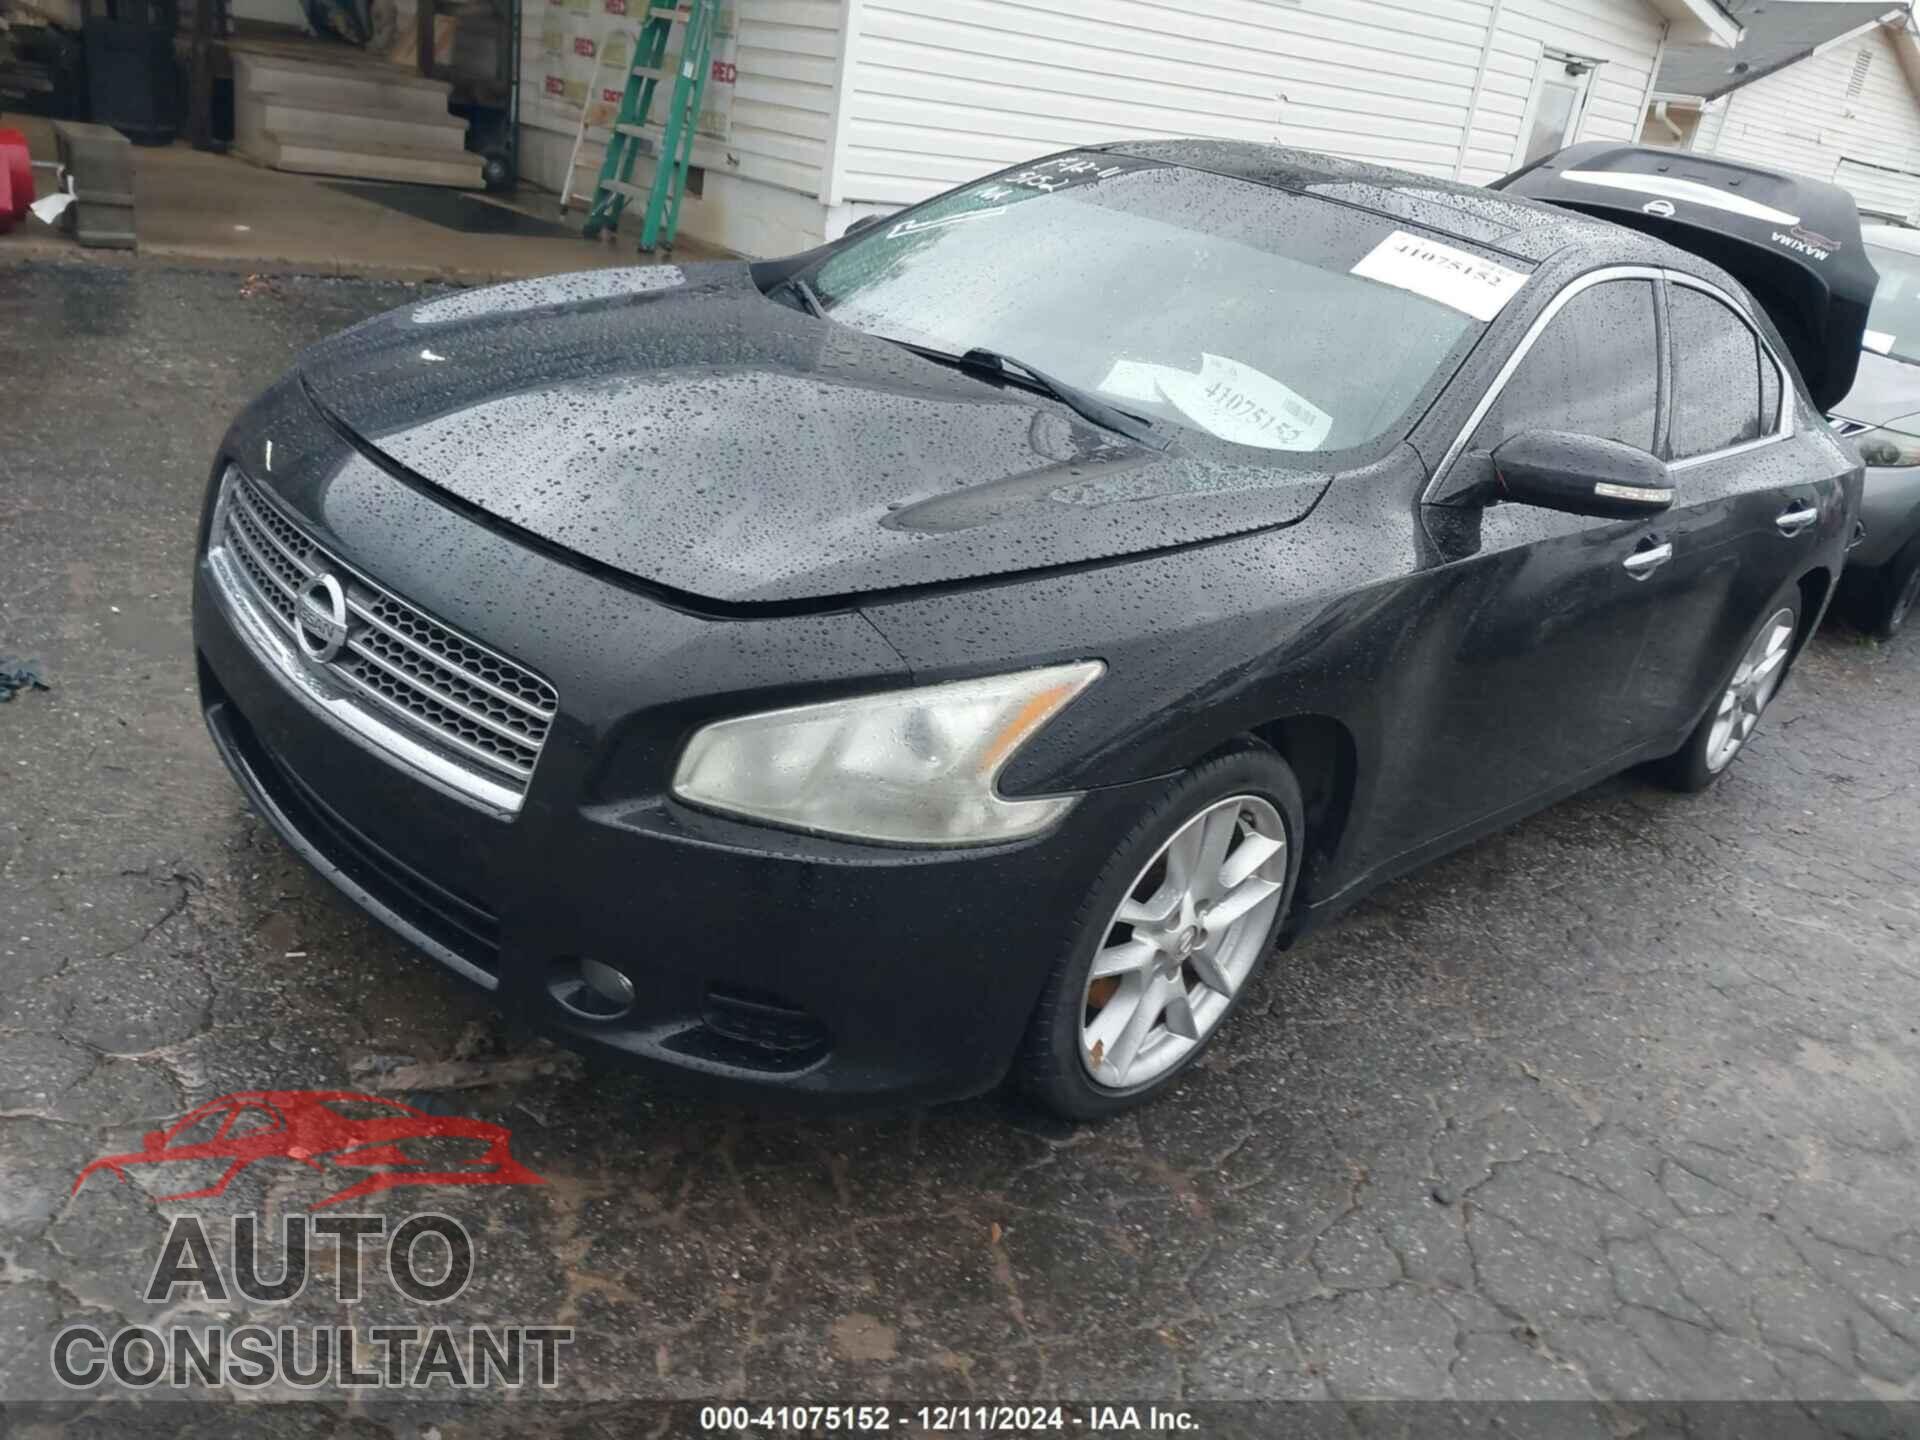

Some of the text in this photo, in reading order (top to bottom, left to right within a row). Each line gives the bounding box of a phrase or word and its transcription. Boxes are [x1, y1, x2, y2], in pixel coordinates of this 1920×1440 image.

[1395, 244, 1503, 287] 41075152
[1771, 232, 1830, 261] MAXIMA
[1204, 381, 1304, 444] 41075152
